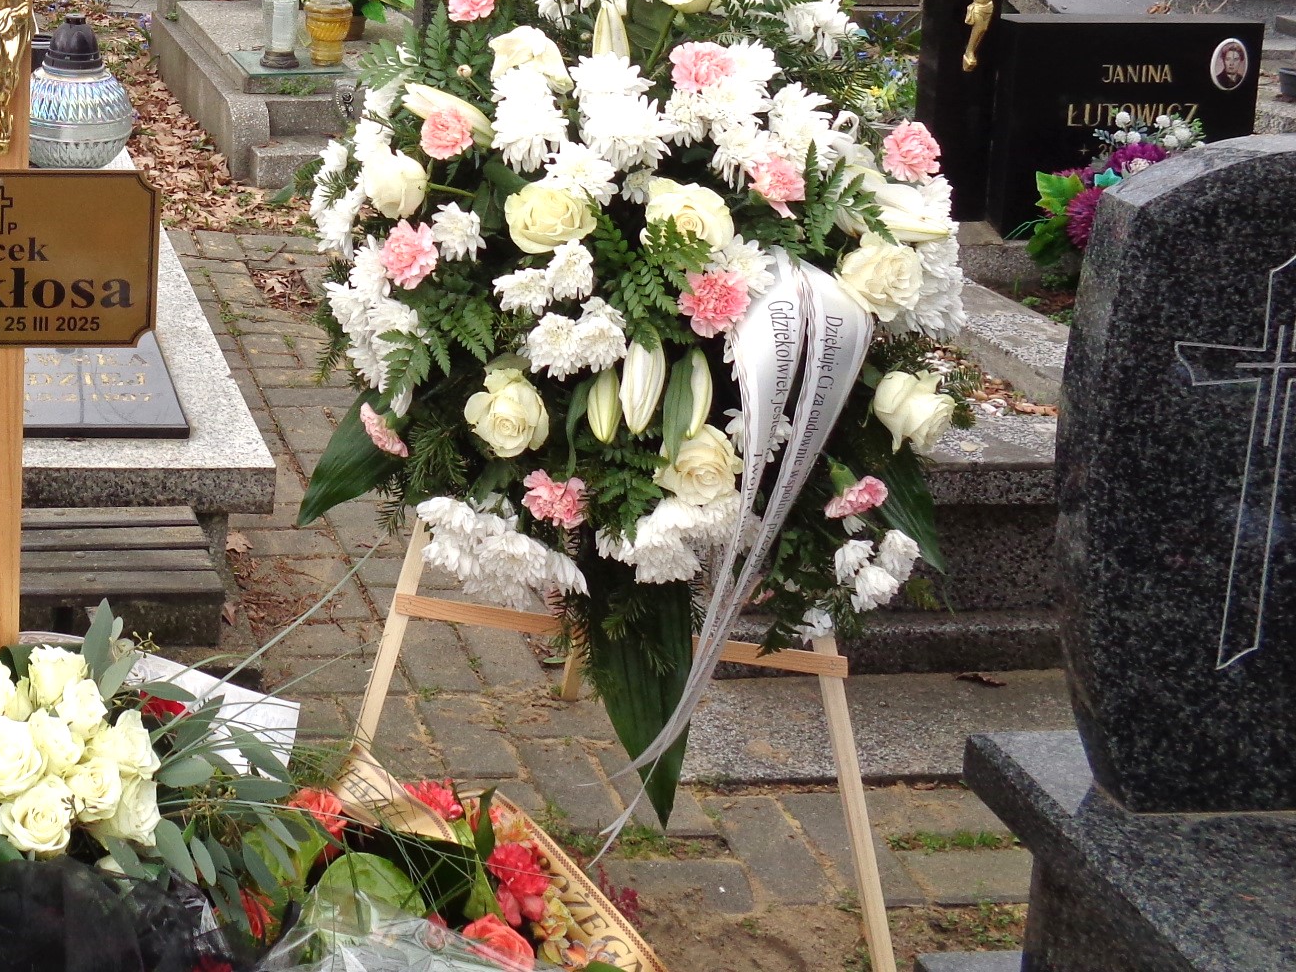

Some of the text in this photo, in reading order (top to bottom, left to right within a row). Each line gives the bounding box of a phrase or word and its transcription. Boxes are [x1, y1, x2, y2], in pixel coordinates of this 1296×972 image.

[1101, 64, 1173, 83] JANINA
[5, 316, 26, 332] 25
[33, 316, 49, 332] III
[55, 316, 100, 332] 2025
[768, 300, 796, 397] Gdziekolwiek
[817, 315, 844, 372] Dziękuję
[818, 375, 835, 390] Ci
[813, 393, 826, 407] za
[794, 409, 821, 466] cudownie
